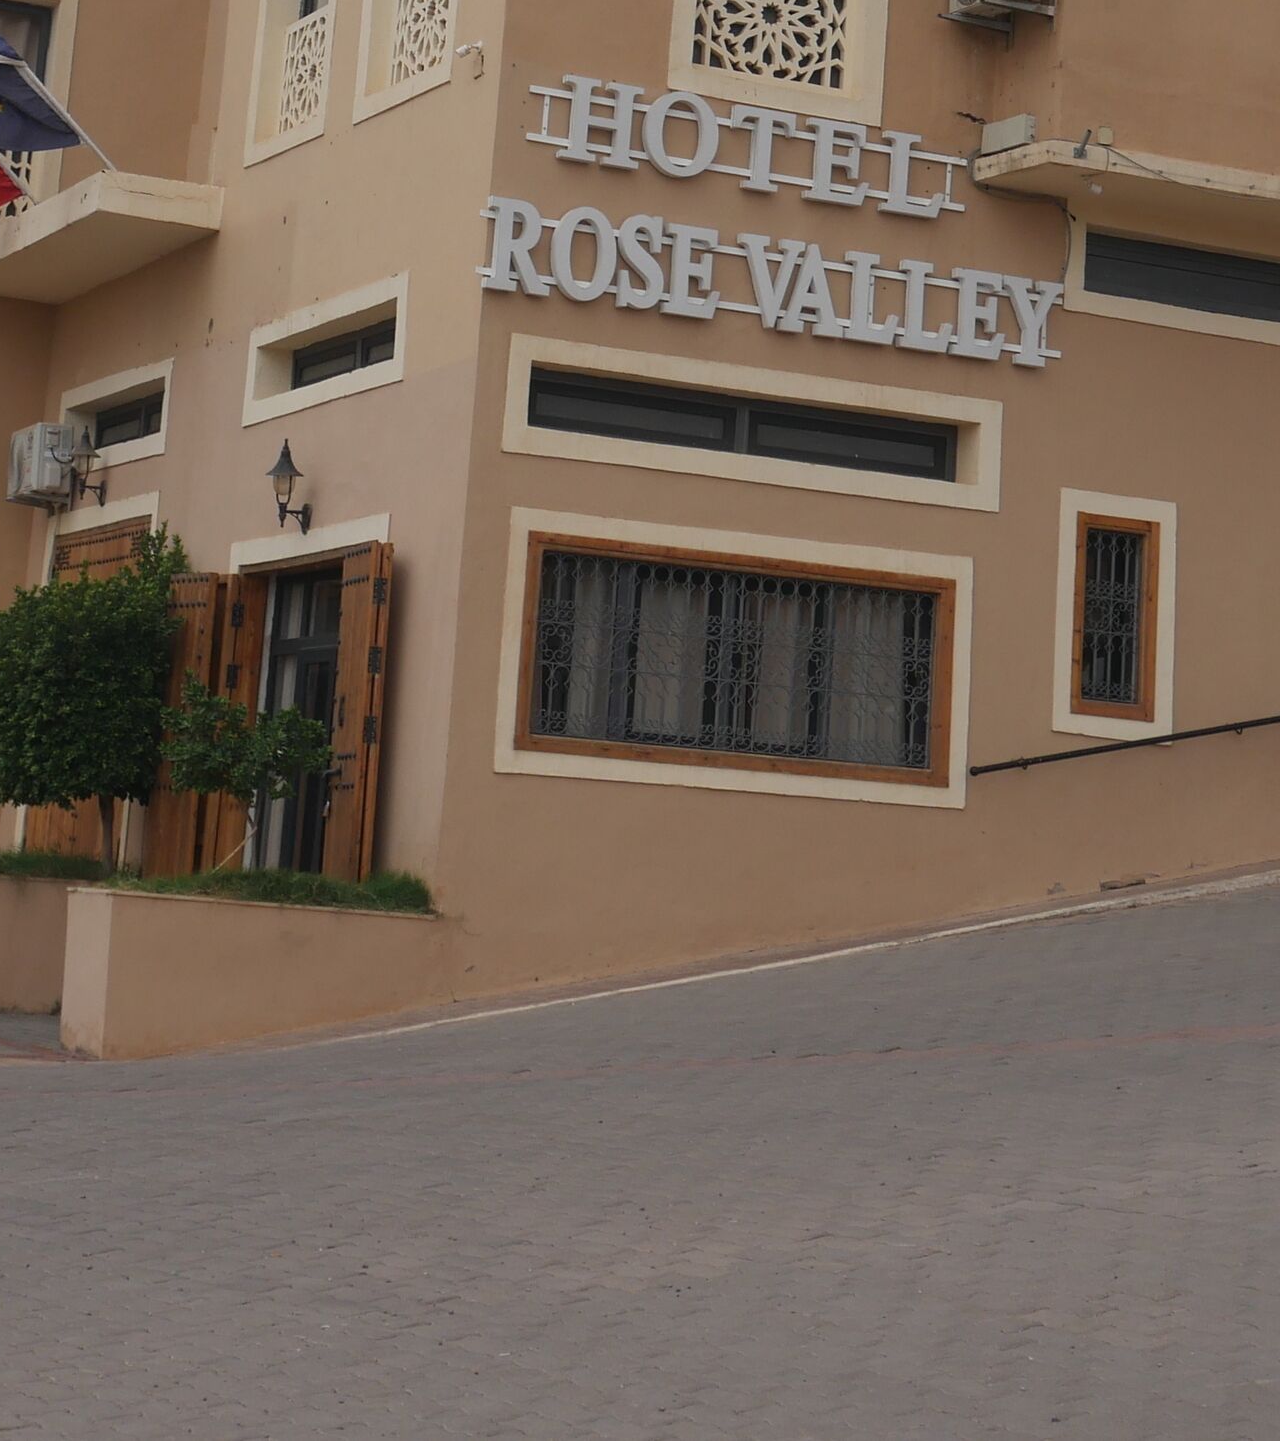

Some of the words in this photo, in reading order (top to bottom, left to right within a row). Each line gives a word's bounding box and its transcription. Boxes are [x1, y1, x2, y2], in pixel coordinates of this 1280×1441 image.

[555, 73, 944, 219] HOTEL
[481, 195, 720, 320] ROSE
[736, 232, 1065, 368] VALLEY
